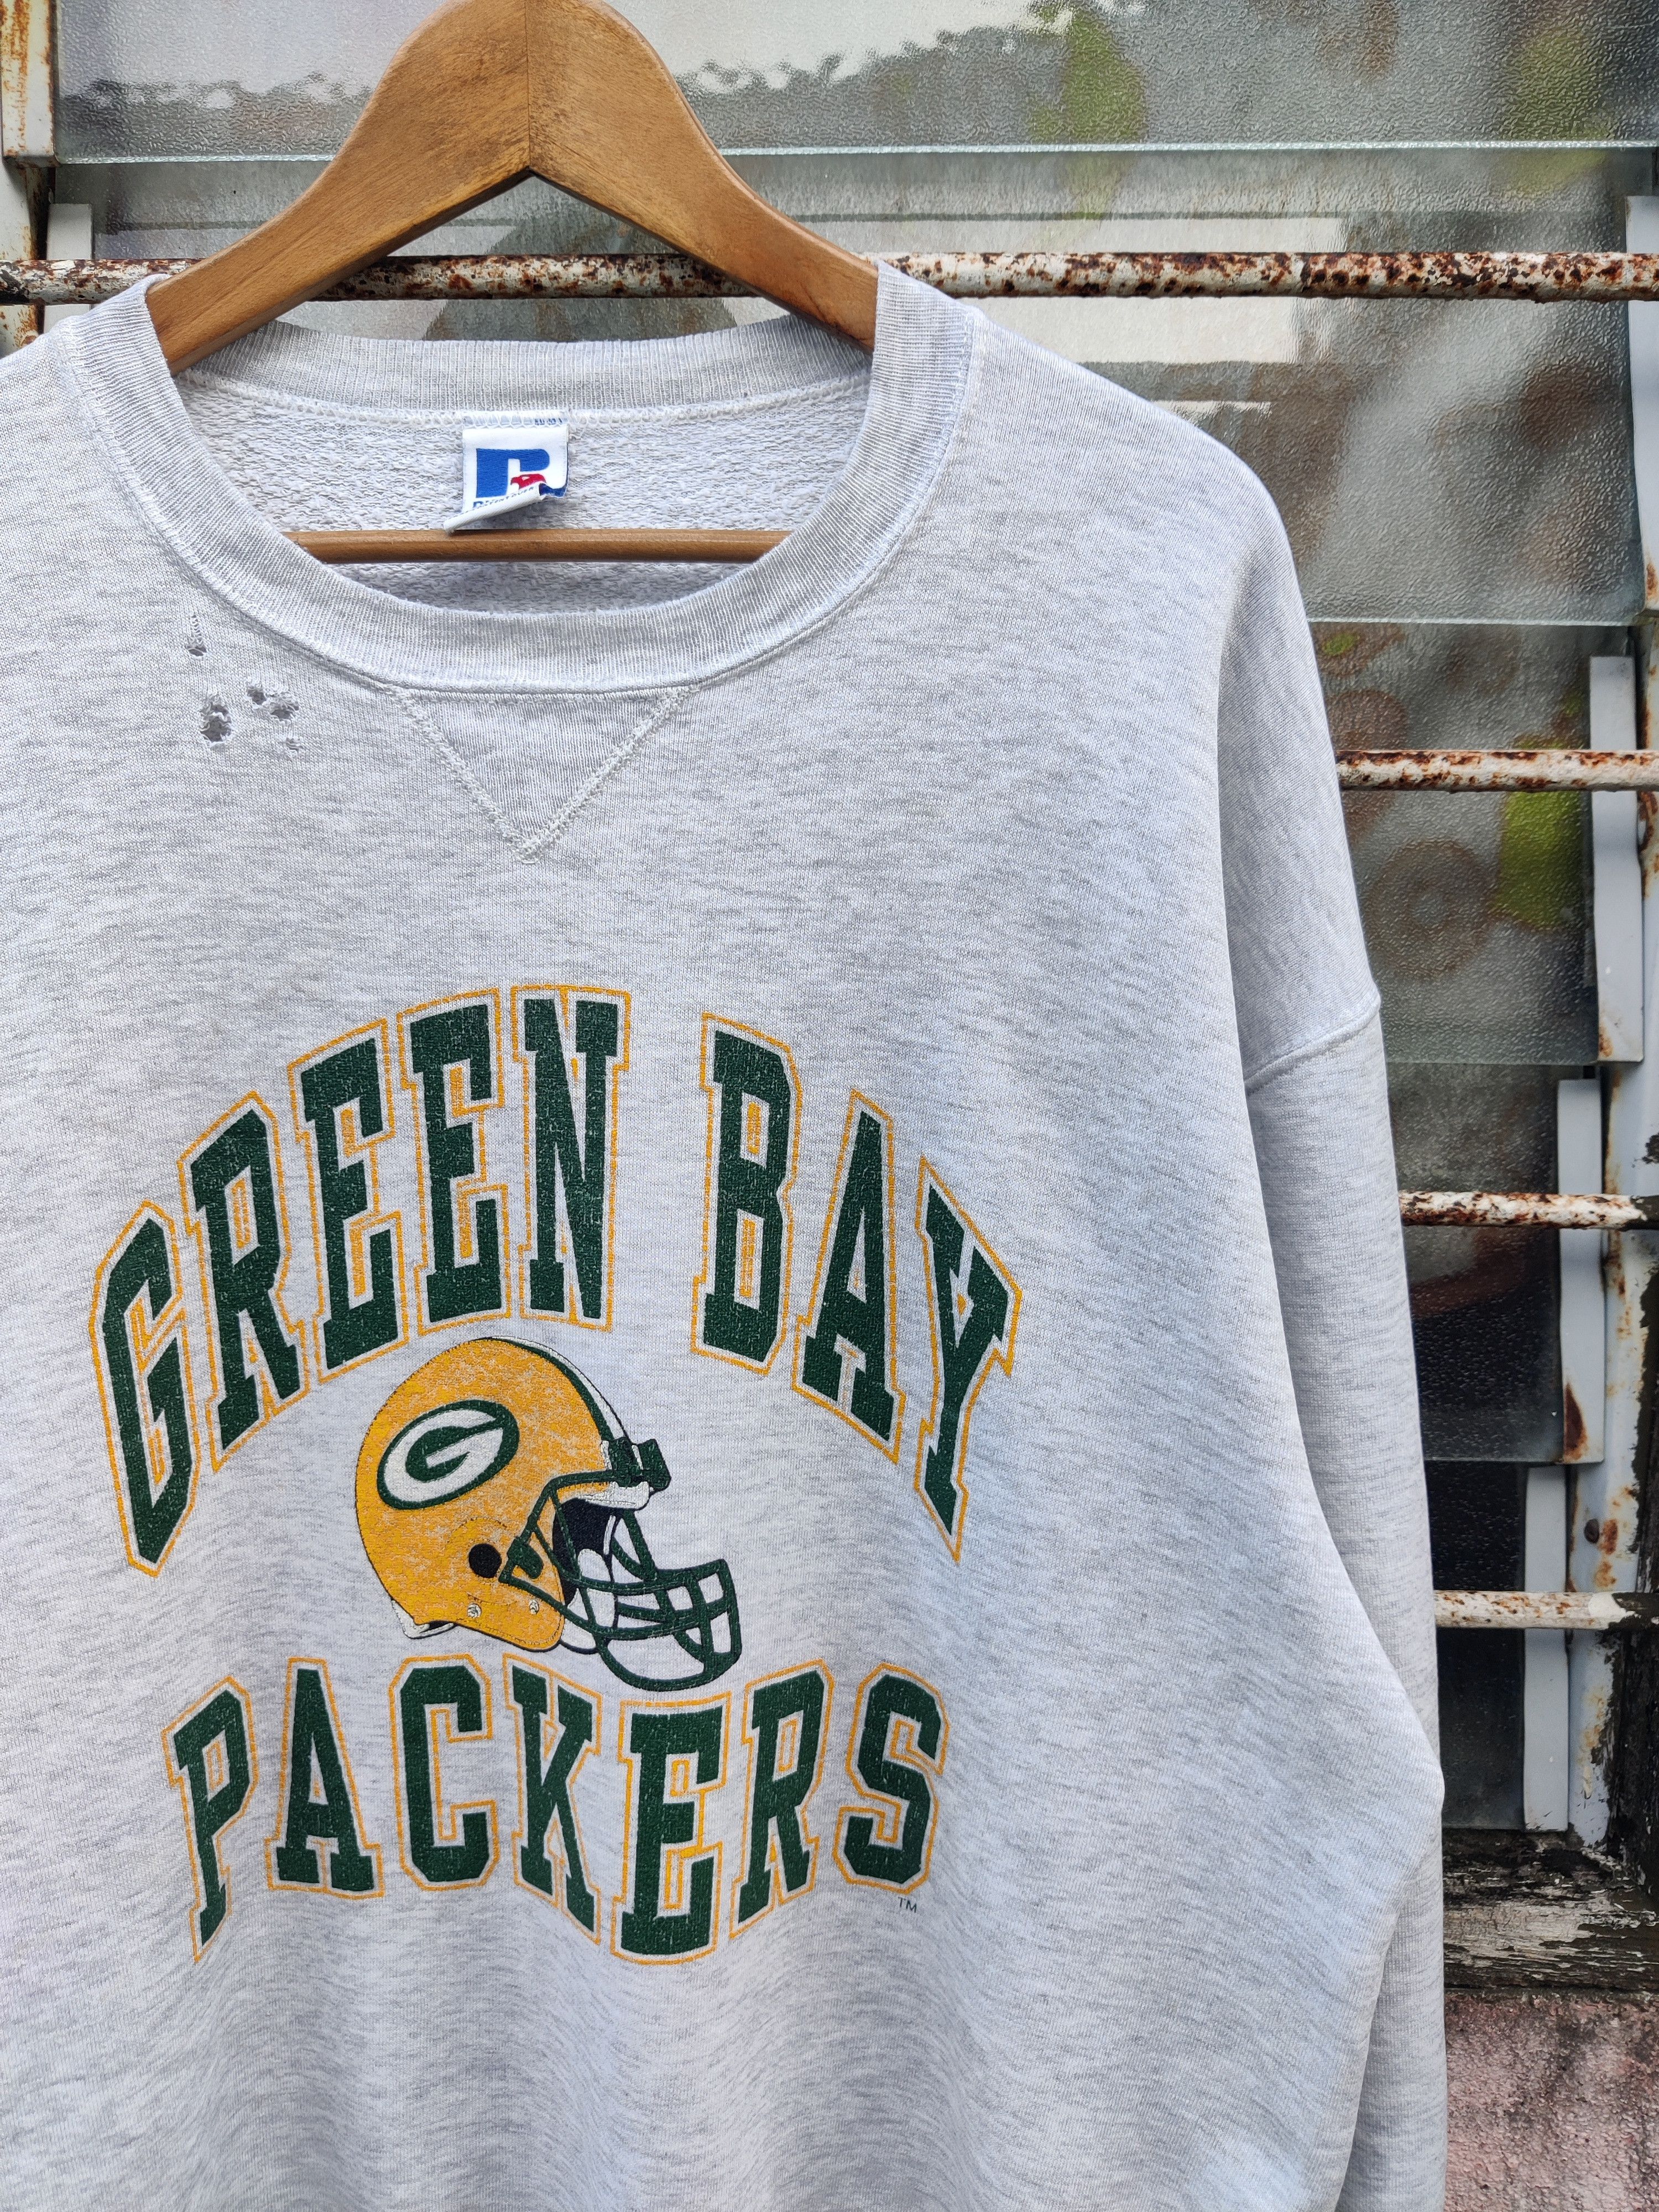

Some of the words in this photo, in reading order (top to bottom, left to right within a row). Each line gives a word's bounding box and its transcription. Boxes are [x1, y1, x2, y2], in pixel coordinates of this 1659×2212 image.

[87, 984, 631, 1577] GREEN
[691, 1012, 1022, 1564] BAY
[382, 1407, 505, 1504] G
[161, 1653, 950, 1965] PACKERS
[898, 1896, 917, 1913] TM
